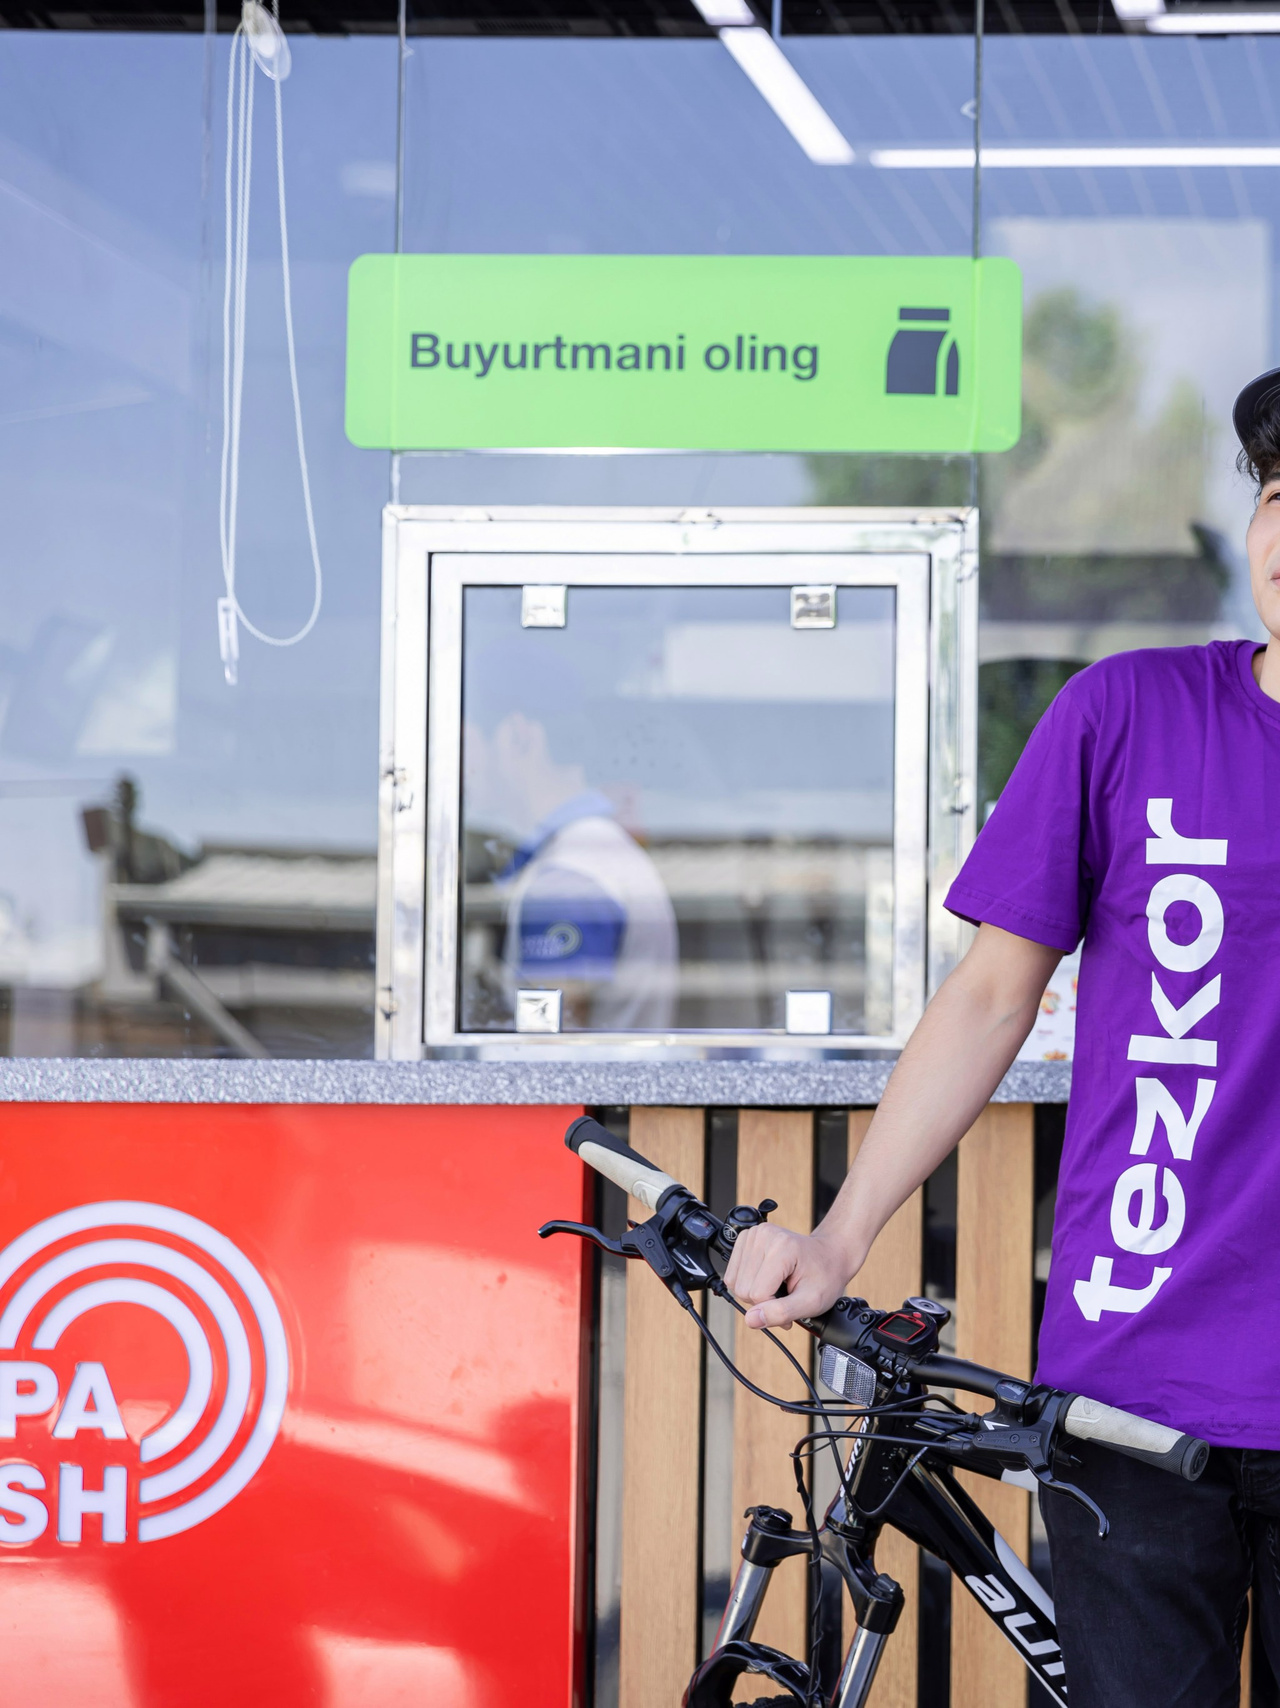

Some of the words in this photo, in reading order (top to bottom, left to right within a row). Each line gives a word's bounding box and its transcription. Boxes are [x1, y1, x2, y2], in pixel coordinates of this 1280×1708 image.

[410, 333, 685, 378] Buyurtmani
[704, 334, 818, 381] oling
[1073, 797, 1229, 1322] tezkor
